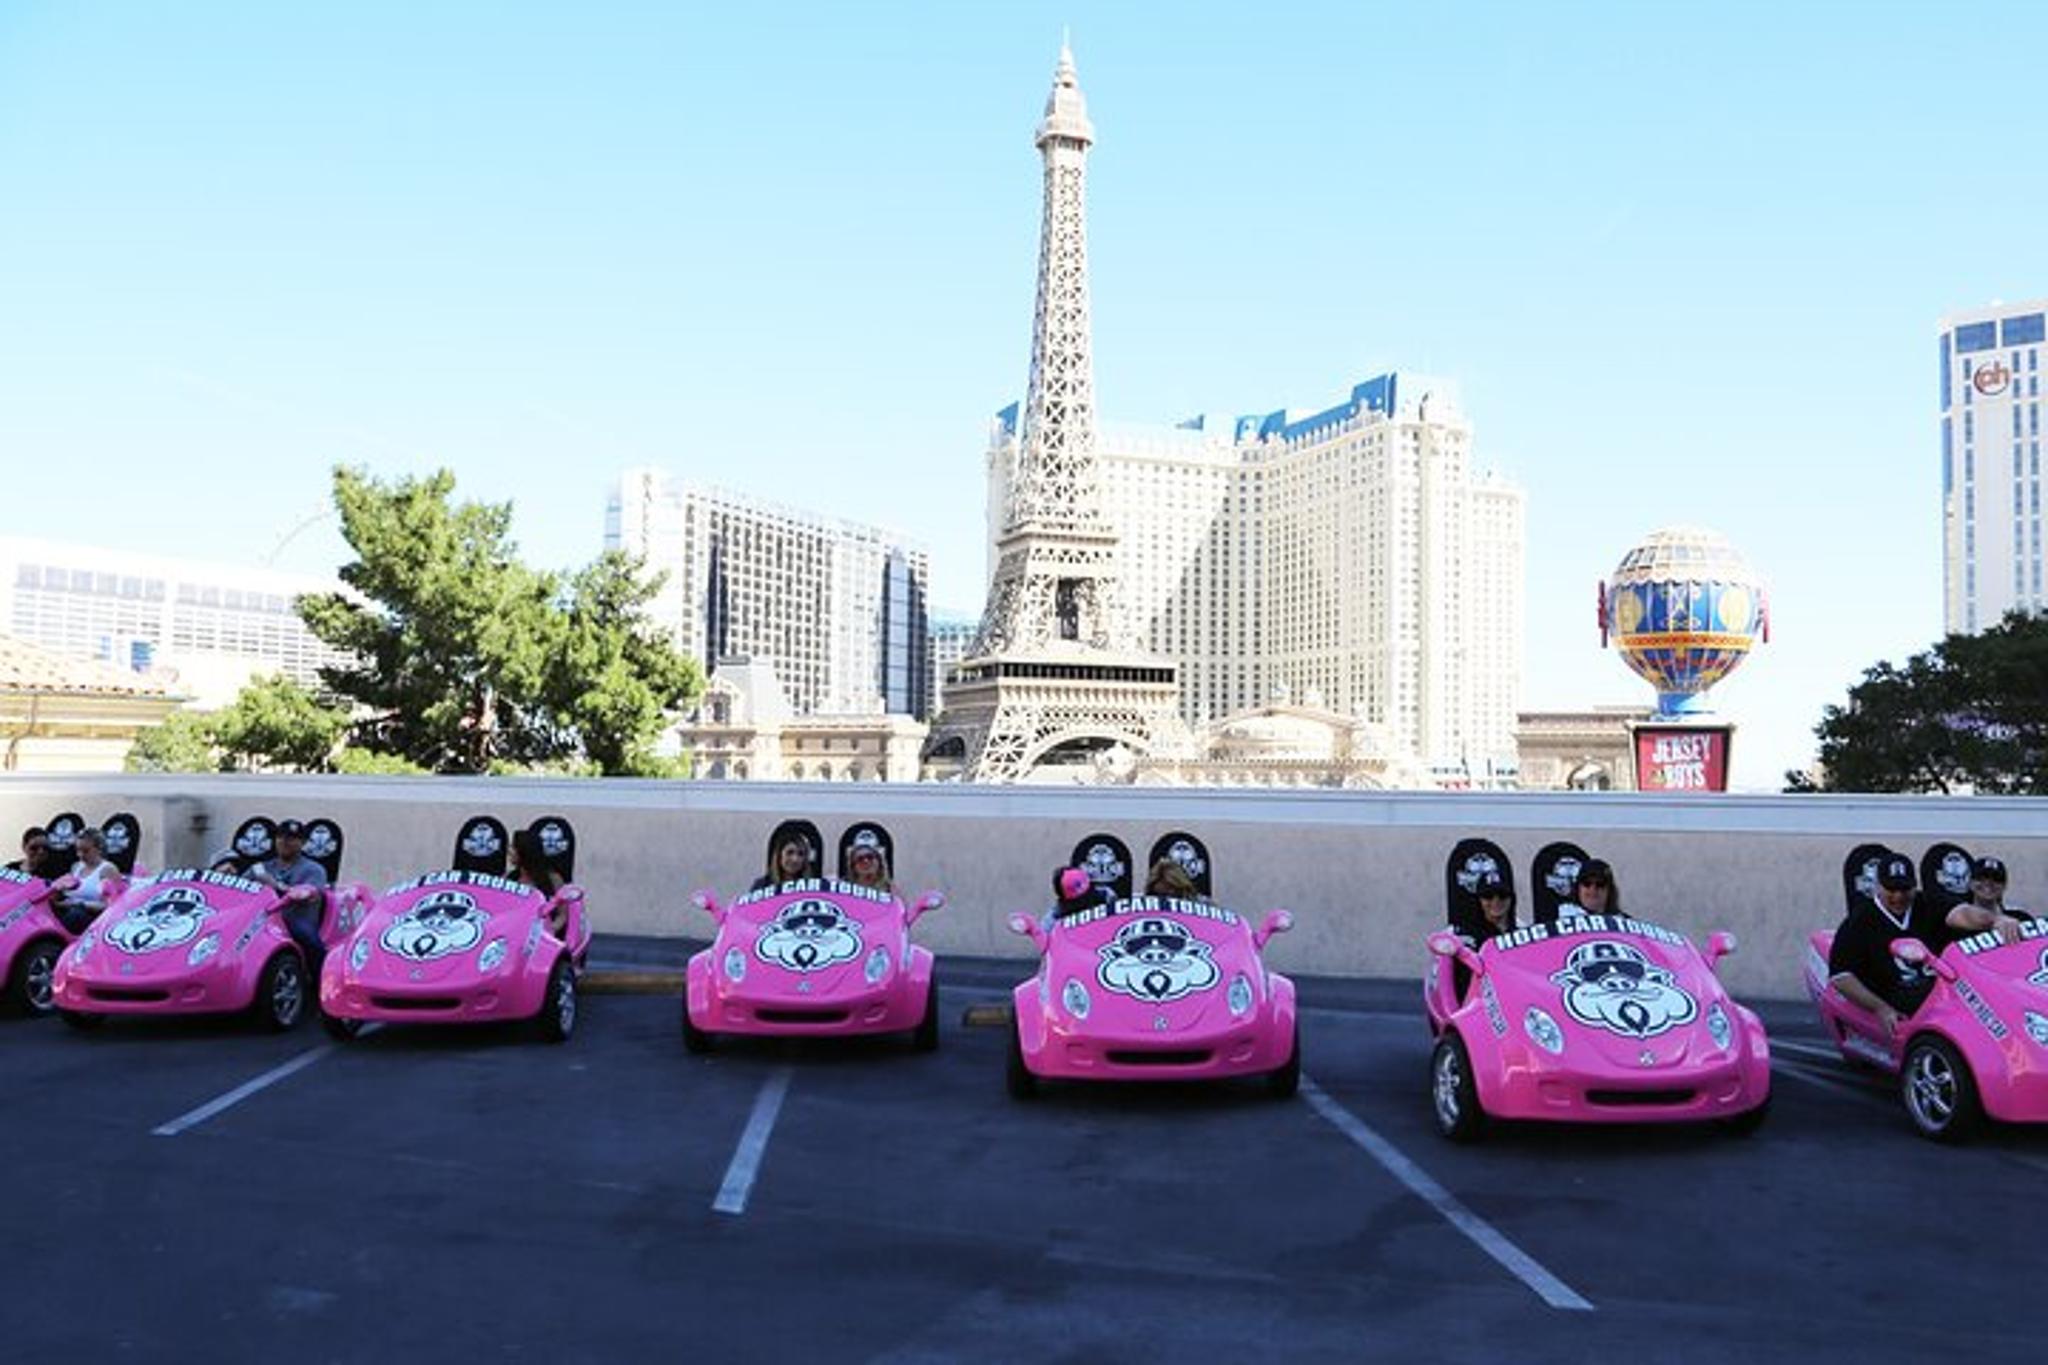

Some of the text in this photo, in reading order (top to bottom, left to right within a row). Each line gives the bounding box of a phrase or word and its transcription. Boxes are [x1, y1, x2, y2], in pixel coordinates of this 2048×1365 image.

[1653, 733, 1710, 764] JERSEY
[201, 869, 263, 893] TOURS
[468, 871, 532, 896] TOURS
[781, 878, 821, 894] CAR
[829, 881, 892, 903] TOURS
[1062, 898, 1239, 928] HOG CAR TOURS
[1495, 924, 1549, 951] HOG
[1555, 915, 1608, 935] CAR
